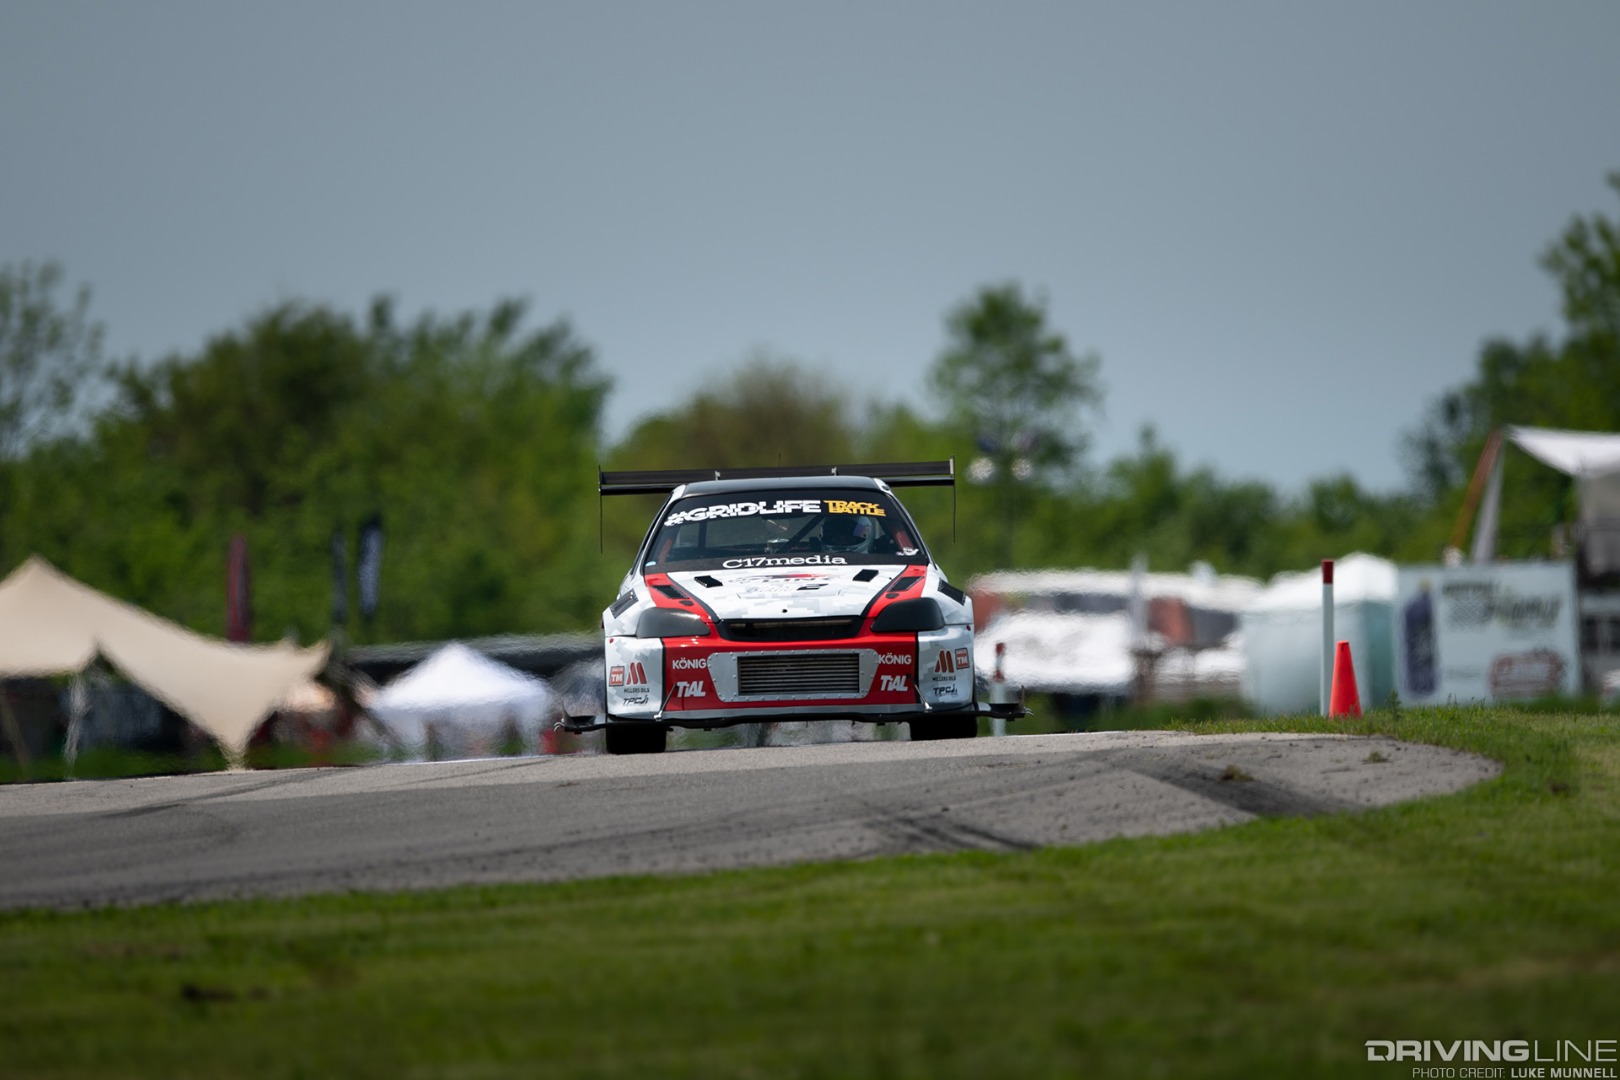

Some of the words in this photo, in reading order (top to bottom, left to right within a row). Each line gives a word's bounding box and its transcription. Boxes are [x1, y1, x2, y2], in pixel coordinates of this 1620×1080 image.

[722, 555, 848, 569] C17media
[672, 657, 707, 670] KÖNIG
[878, 652, 912, 665] KÖNIG
